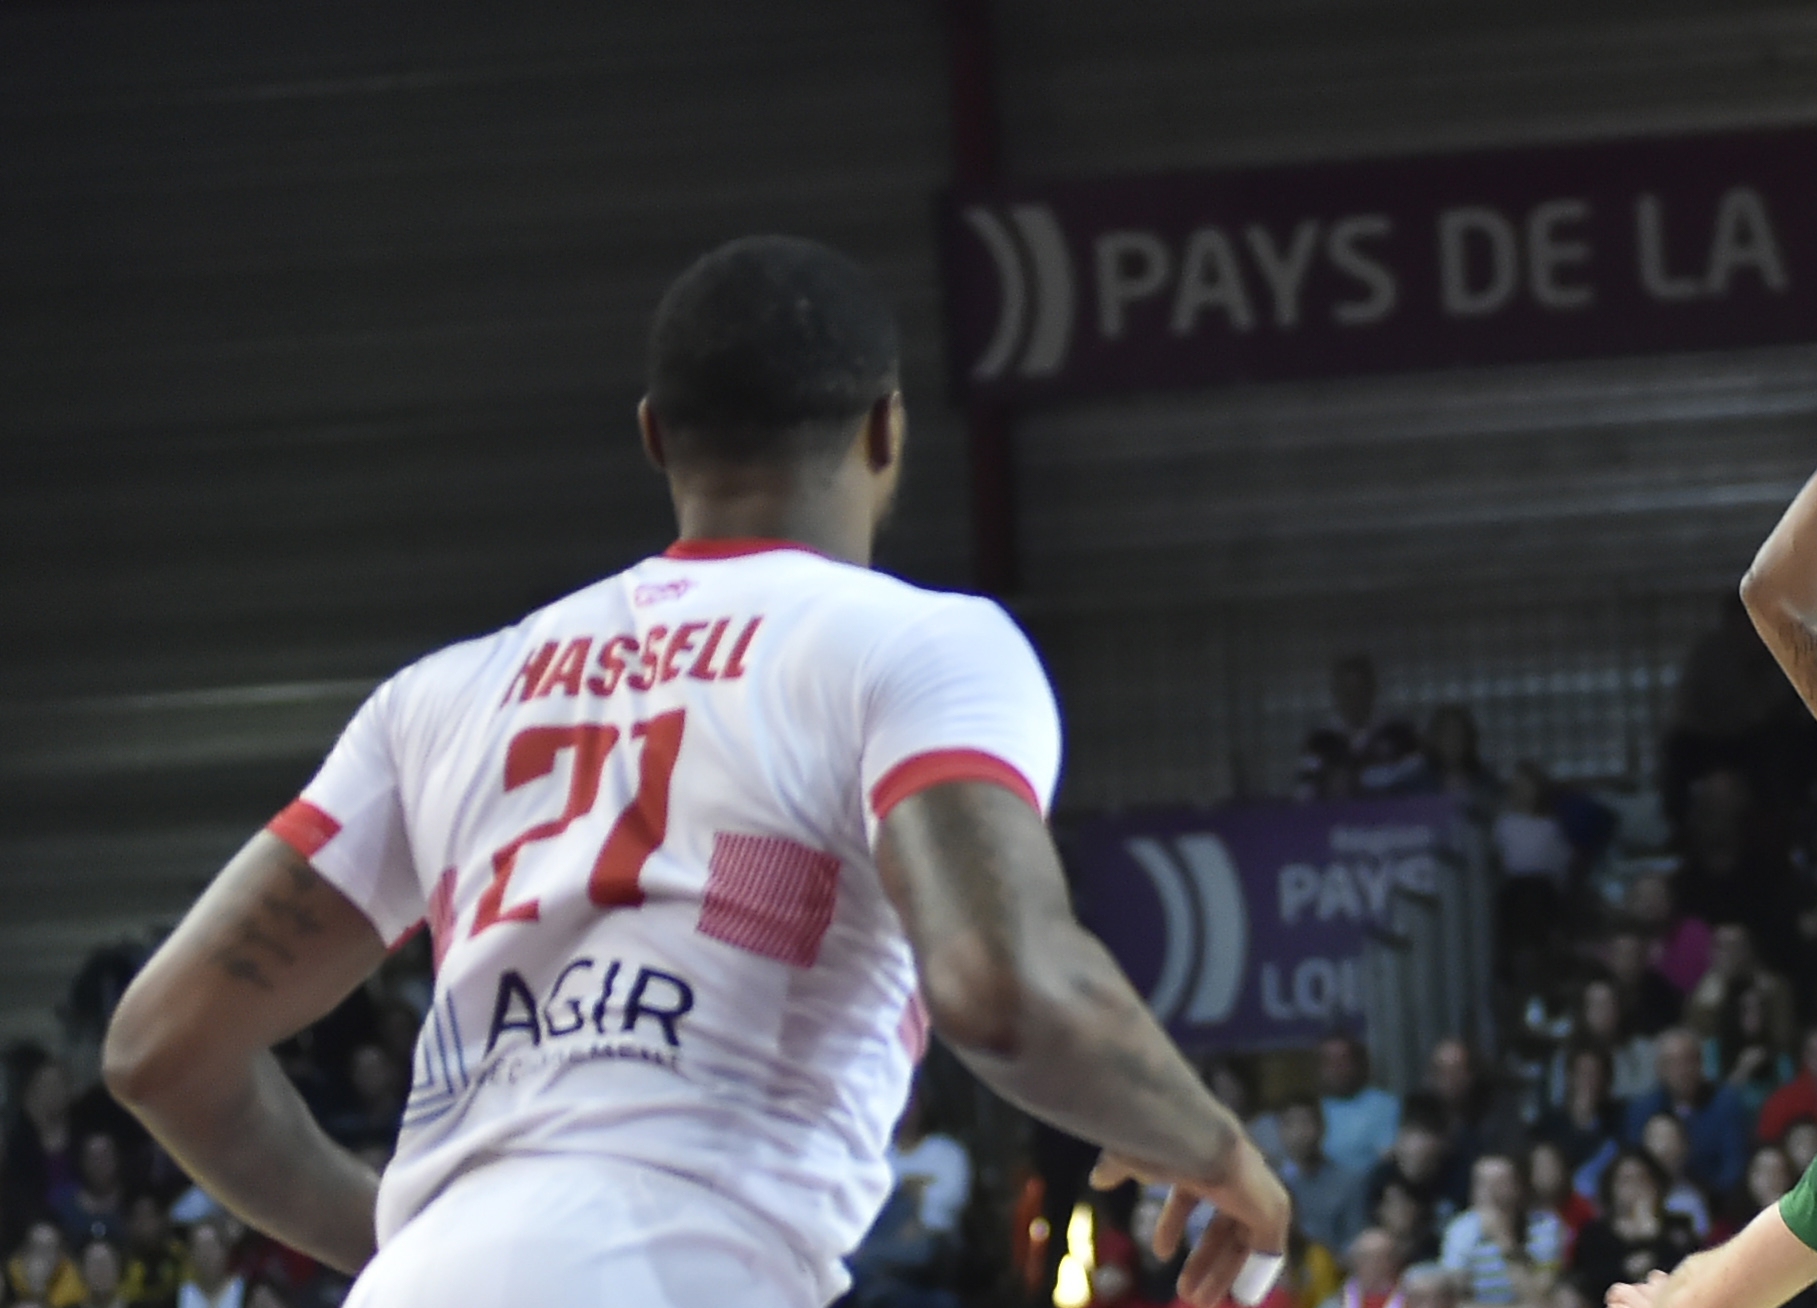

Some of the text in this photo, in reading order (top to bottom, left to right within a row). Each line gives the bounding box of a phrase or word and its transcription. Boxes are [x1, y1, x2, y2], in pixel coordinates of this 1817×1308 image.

[1095, 217, 1397, 342] PAYS
[1435, 194, 1596, 318] DE
[1632, 186, 1789, 303] LA
[500, 615, 764, 706] HASSELL
[469, 708, 686, 938] 21
[485, 960, 694, 1053] AGIR
